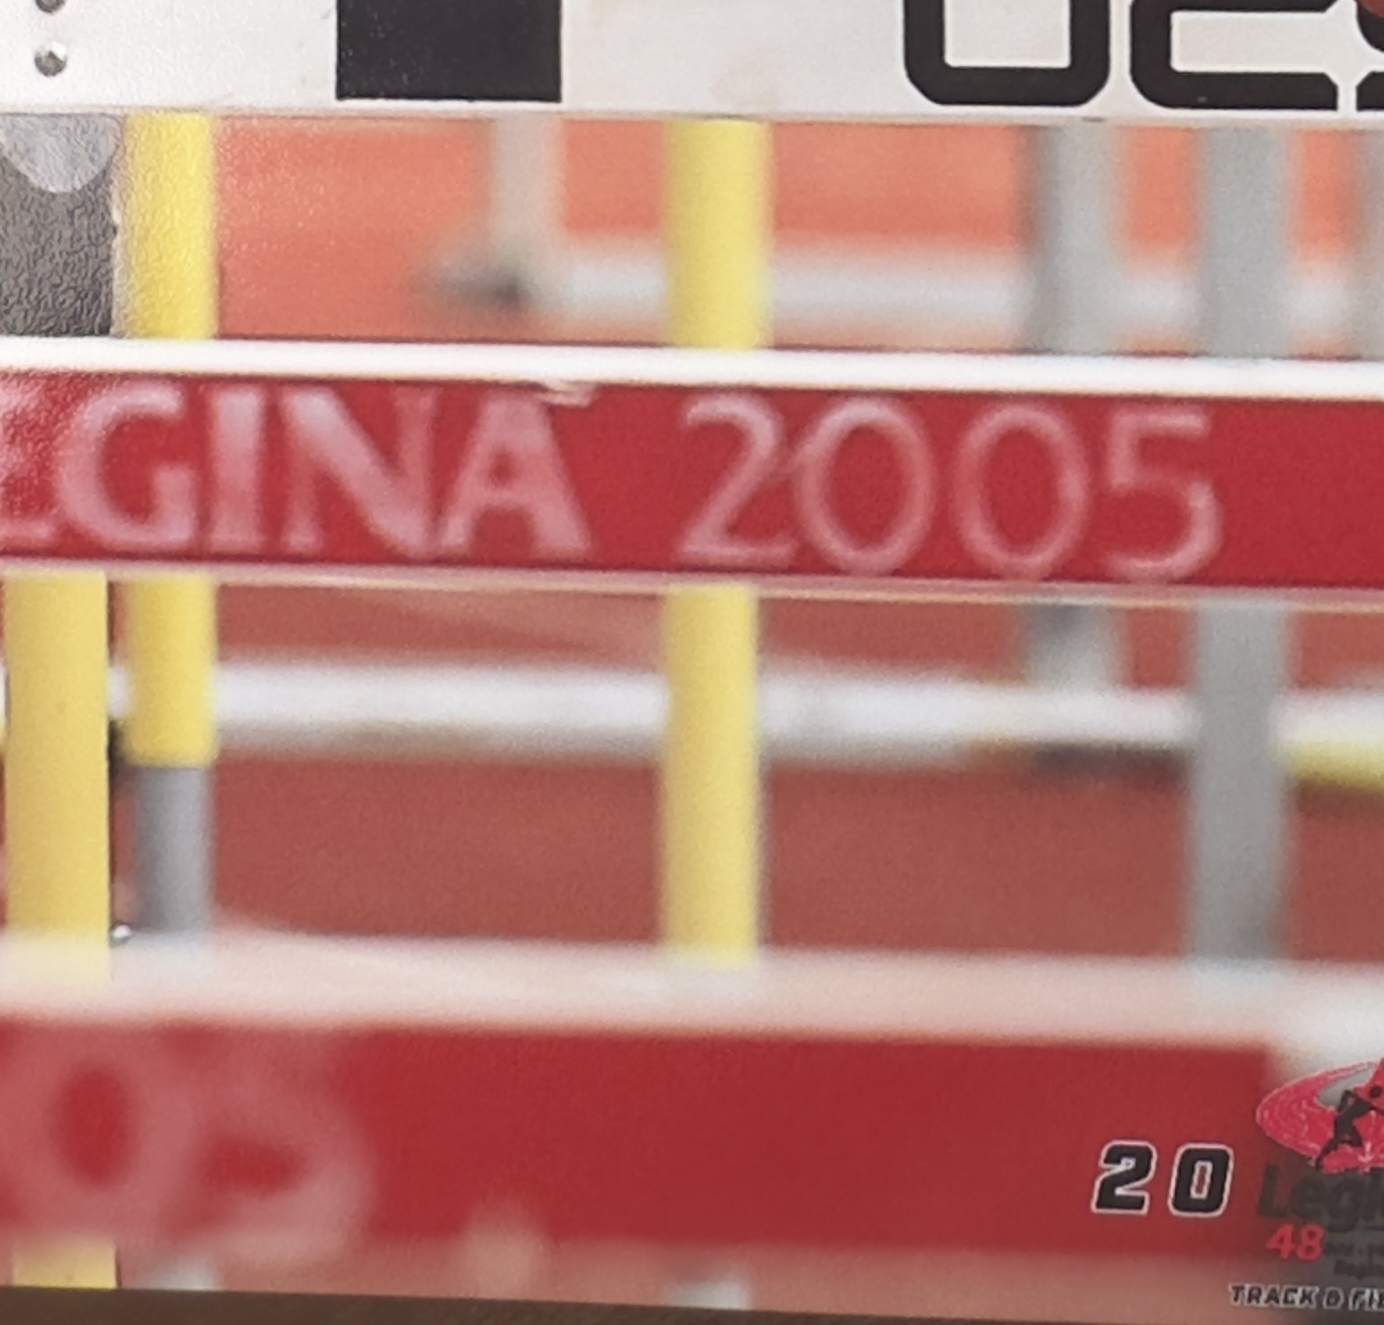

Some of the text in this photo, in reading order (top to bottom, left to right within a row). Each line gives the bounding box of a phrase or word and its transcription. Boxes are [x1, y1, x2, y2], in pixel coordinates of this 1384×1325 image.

[677, 392, 1224, 582] 2005
[1090, 1139, 1235, 1218] 20
[1265, 1222, 1326, 1262] 48
[1229, 1283, 1319, 1309] TRACK
